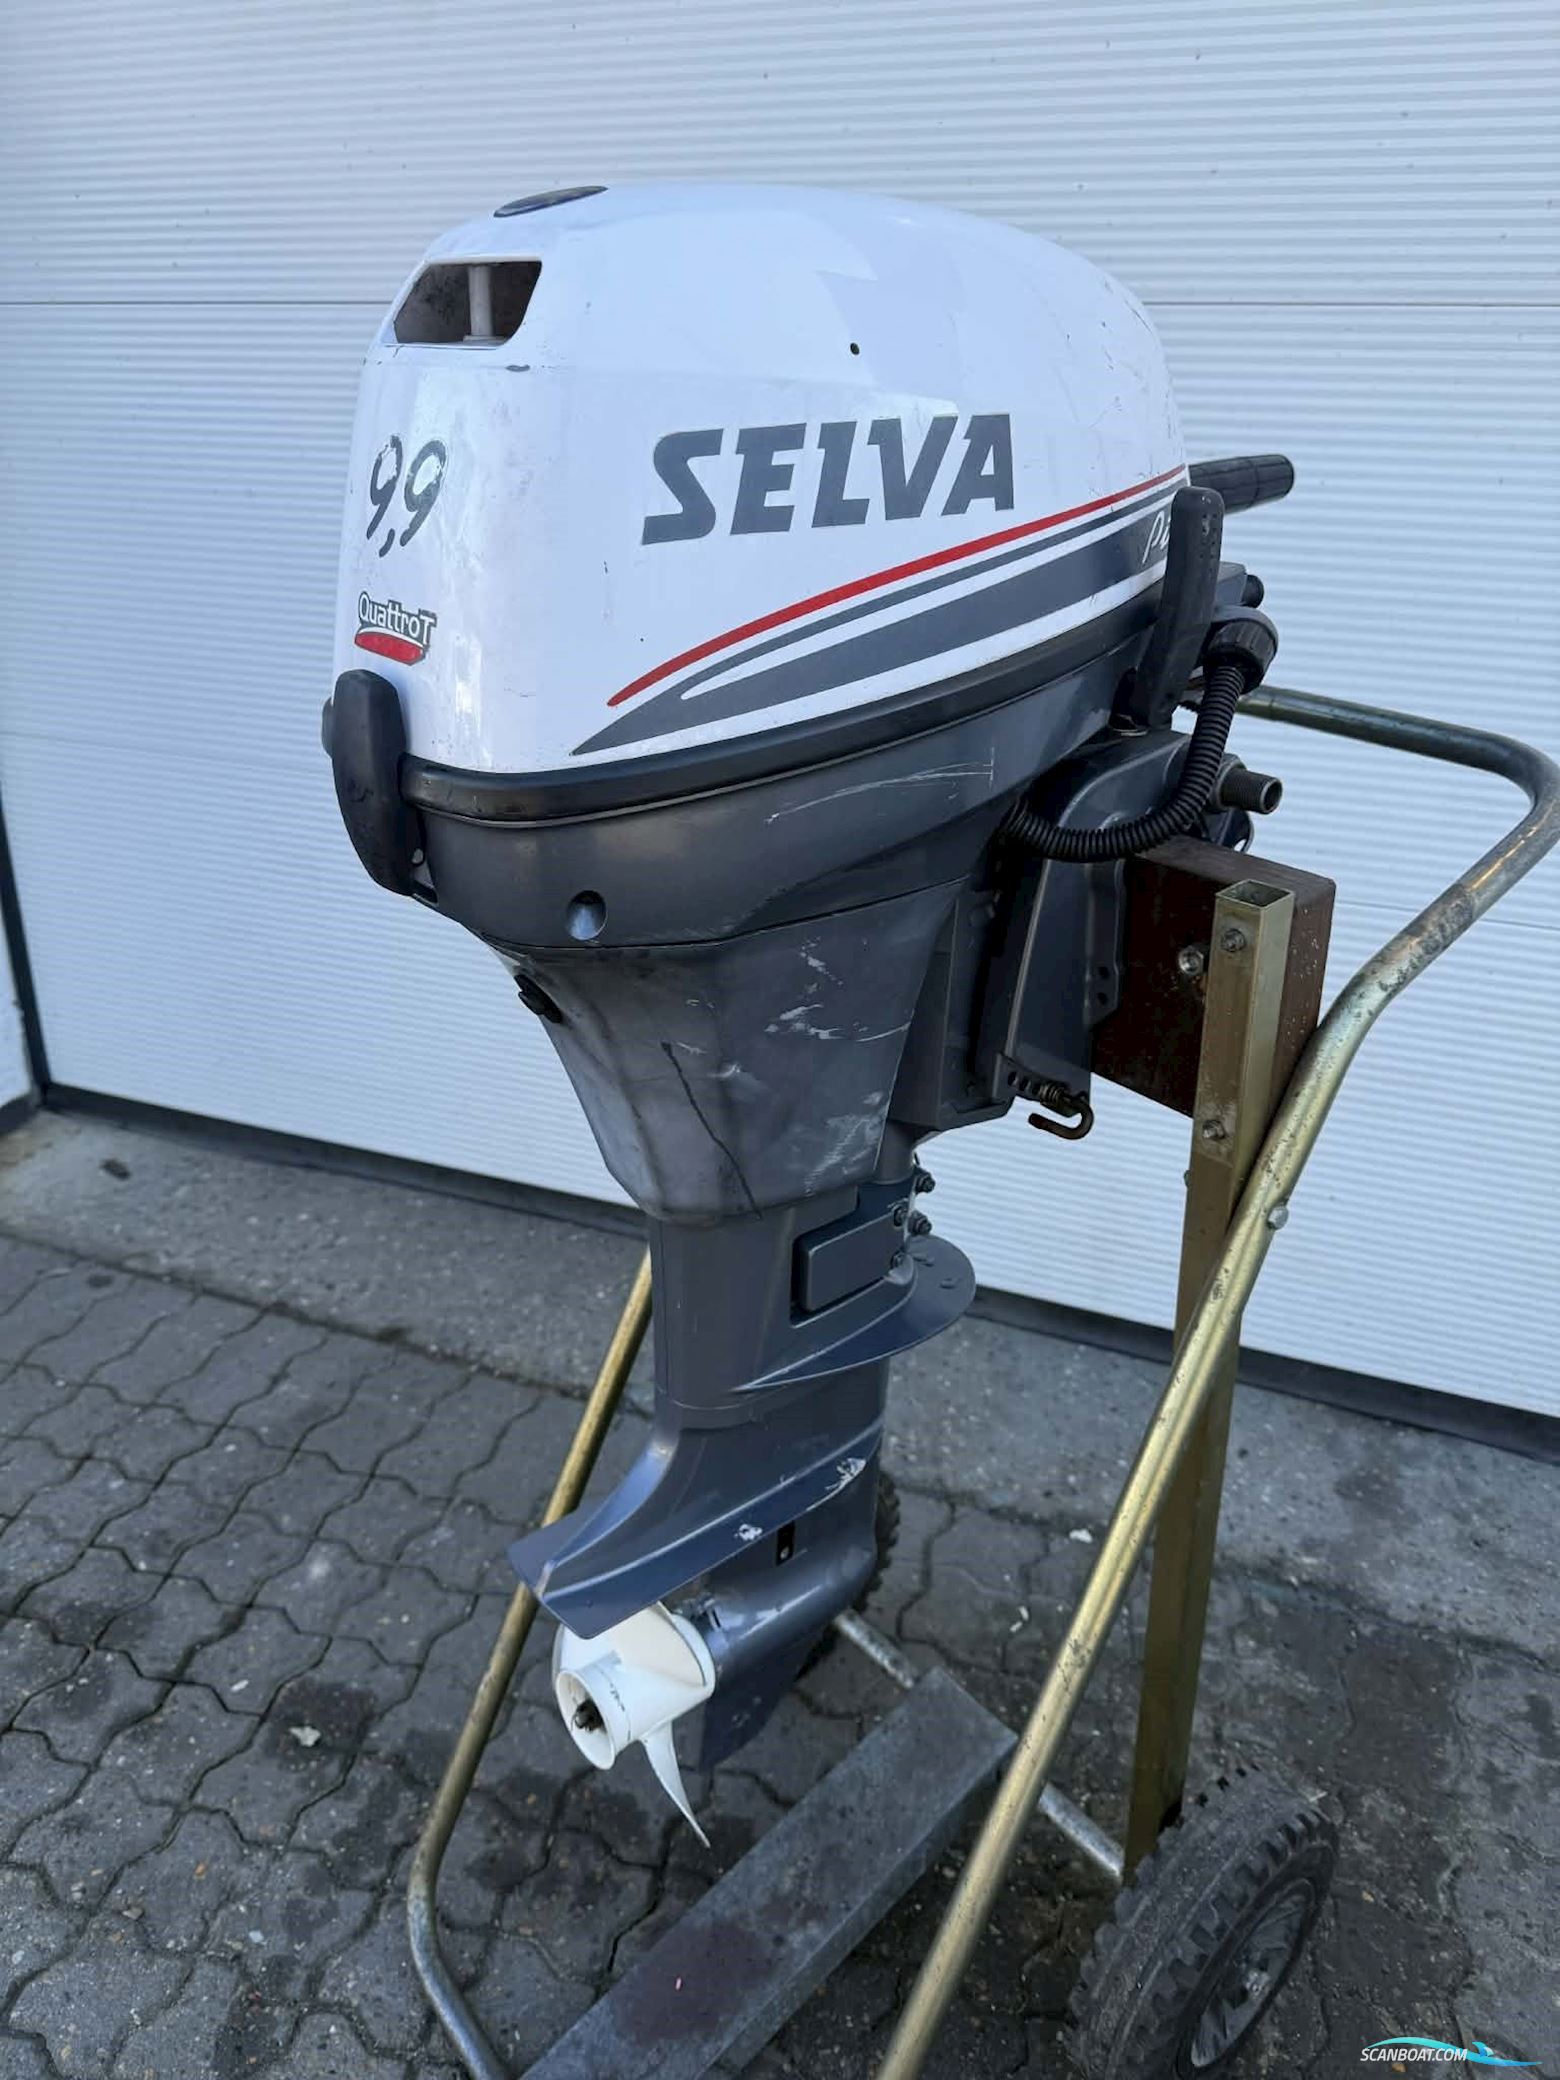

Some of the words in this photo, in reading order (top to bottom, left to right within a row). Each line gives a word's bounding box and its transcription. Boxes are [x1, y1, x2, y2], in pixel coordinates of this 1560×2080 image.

[366, 434, 447, 558] 9,9
[641, 412, 1015, 545] SELVA
[358, 590, 437, 650] QuattroT
